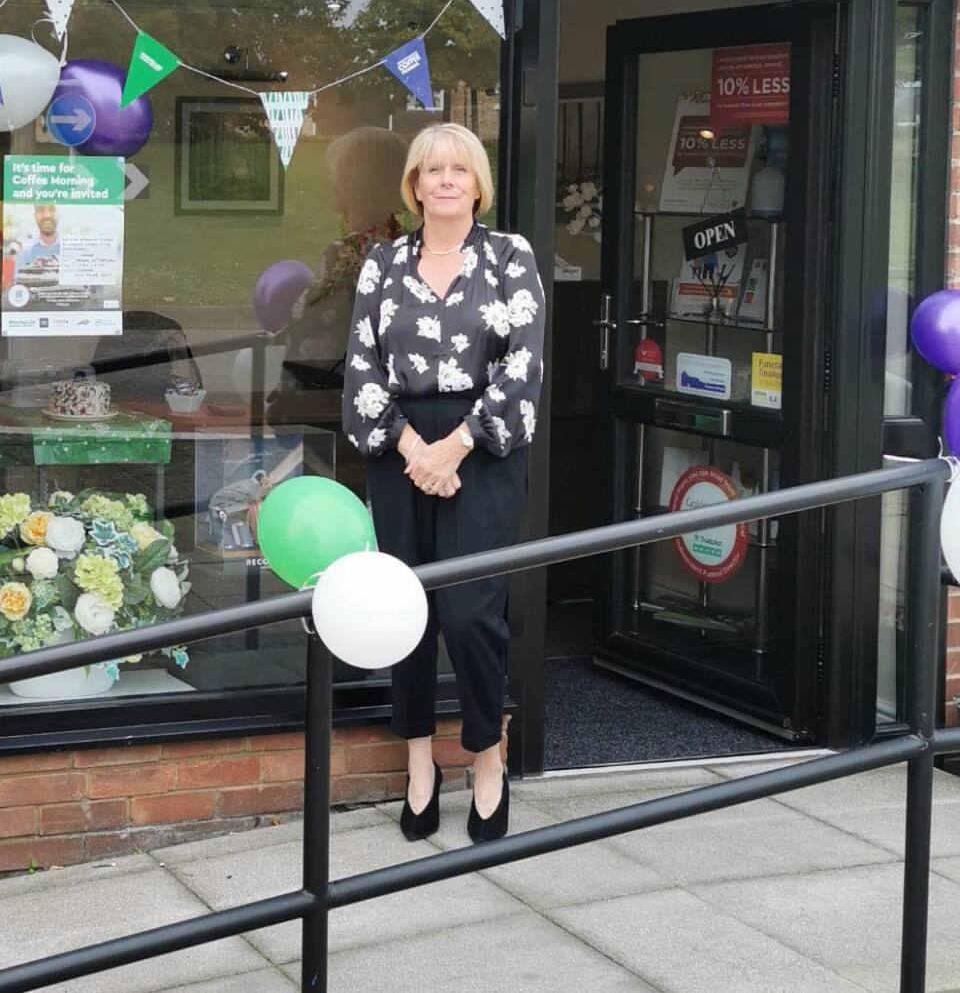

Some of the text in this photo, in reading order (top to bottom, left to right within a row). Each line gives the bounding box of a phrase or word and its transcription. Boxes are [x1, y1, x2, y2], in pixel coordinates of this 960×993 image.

[717, 76, 791, 96] 10% LESS
[679, 136, 746, 151] 10% LESS
[12, 162, 76, 174] It's time for
[12, 175, 95, 188] Coffee Morning
[12, 188, 109, 200] and you're invited
[694, 220, 737, 249] OPEN
